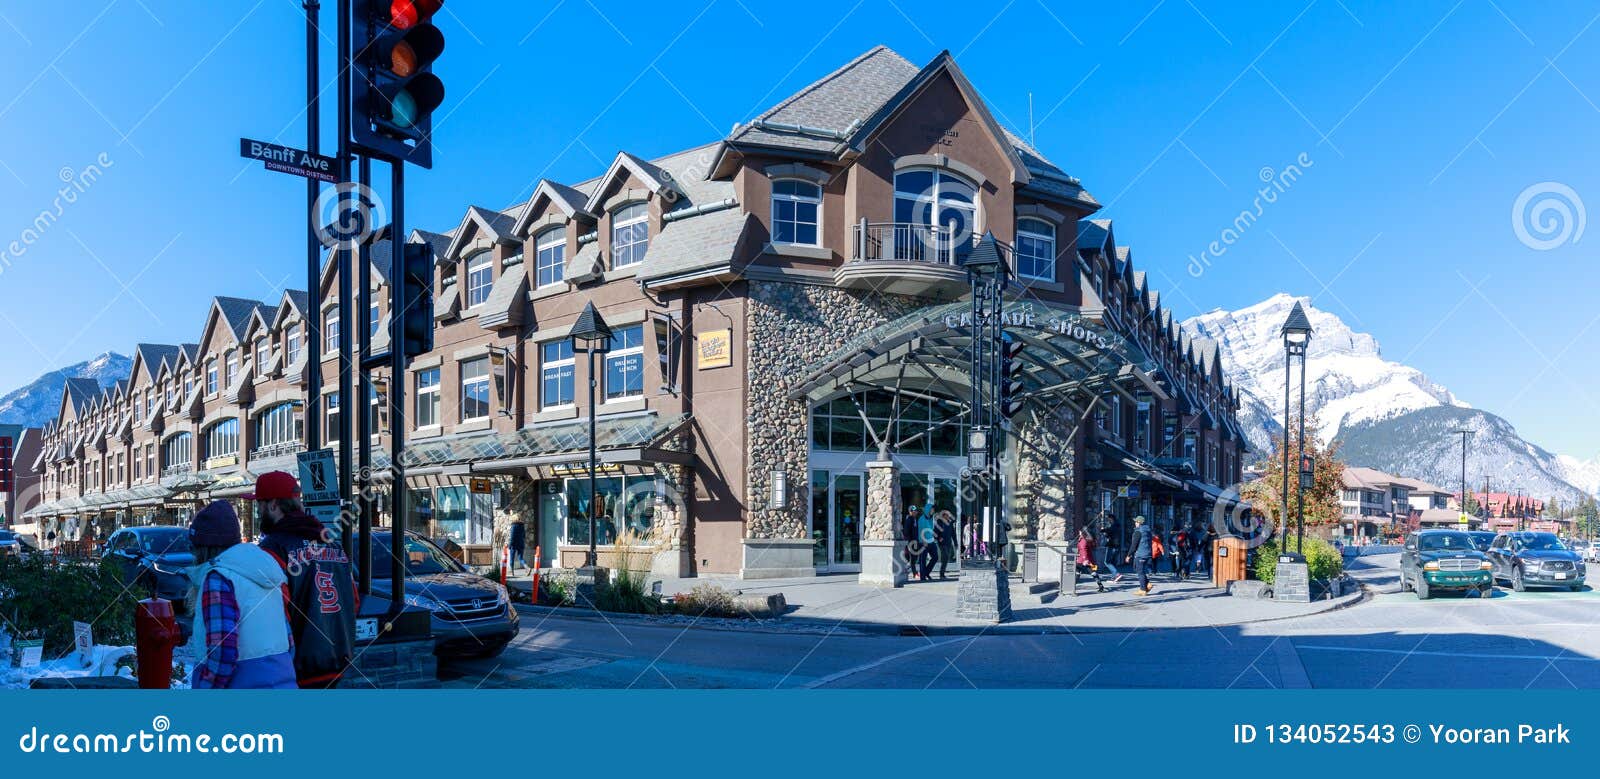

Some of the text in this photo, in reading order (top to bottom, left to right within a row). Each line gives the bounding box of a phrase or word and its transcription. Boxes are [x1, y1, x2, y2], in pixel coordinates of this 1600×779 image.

[250, 142, 329, 171] Banff Ave
[1048, 317, 1107, 350] SHOPS
